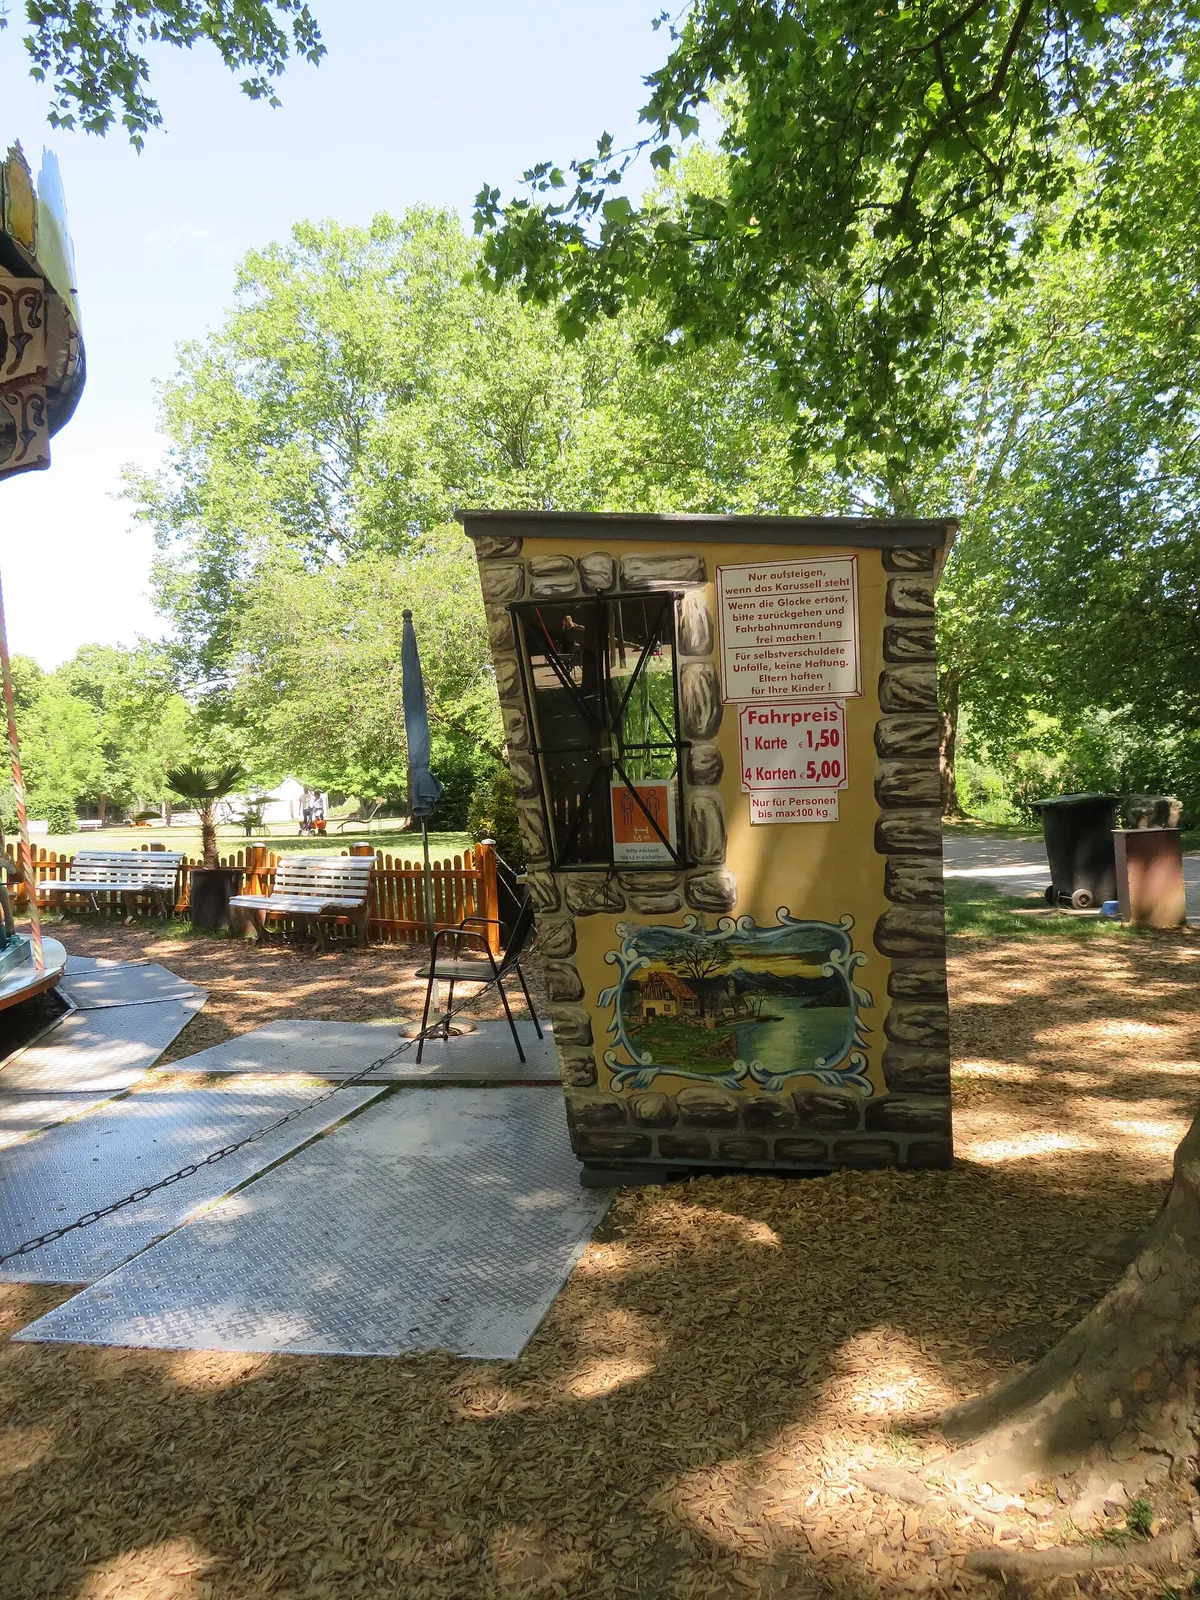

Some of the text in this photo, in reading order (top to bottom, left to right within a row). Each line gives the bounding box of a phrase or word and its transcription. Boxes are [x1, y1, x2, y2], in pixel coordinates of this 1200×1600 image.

[748, 569, 826, 581] Nur aufsteigen,
[755, 584, 772, 592] das
[776, 580, 821, 591] Karussell
[825, 578, 850, 587] steht
[728, 595, 848, 610] Wenn die Glocke ertönt,
[758, 610, 822, 620] zurückgehen
[826, 607, 845, 615] und
[736, 620, 842, 633] Fahrbahnumrandung
[756, 636, 772, 644] frei
[776, 631, 815, 642] machen
[736, 647, 845, 660] Für selbstverschuldete
[733, 660, 848, 672] Unfälle, keine Haftung.
[759, 672, 822, 682] Eltern haften
[769, 686, 788, 694] Ihre
[792, 684, 825, 692] Kinder
[748, 707, 838, 727] Fahrpreis
[755, 736, 787, 750] Karte
[807, 729, 839, 751] 1,50
[745, 768, 752, 780] 4
[756, 767, 796, 780] Karten
[807, 760, 840, 782] 5,00
[773, 798, 786, 806] für
[789, 797, 836, 805] Personen
[758, 810, 772, 818] bis
[816, 809, 830, 817] kg.
